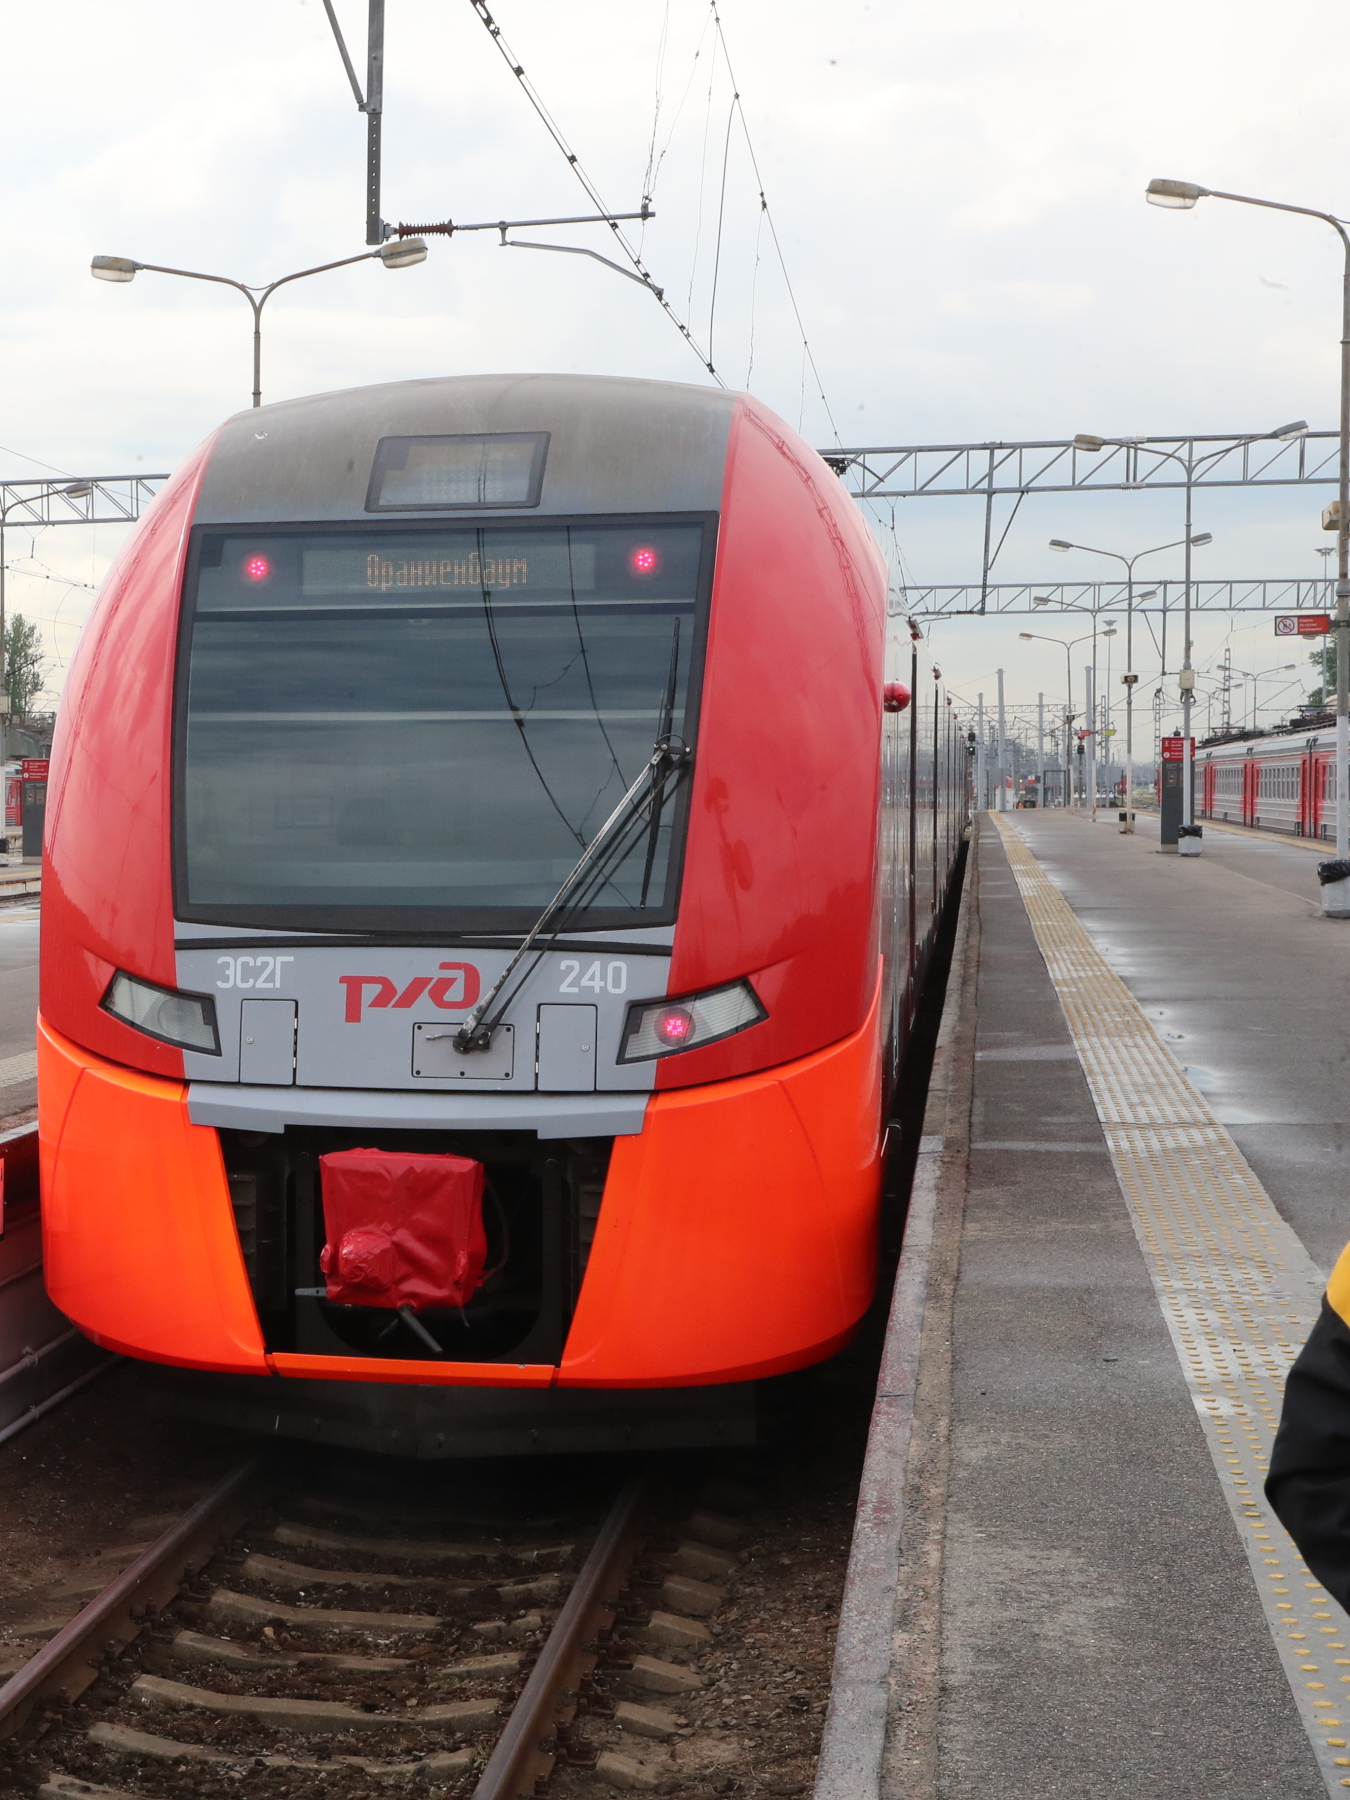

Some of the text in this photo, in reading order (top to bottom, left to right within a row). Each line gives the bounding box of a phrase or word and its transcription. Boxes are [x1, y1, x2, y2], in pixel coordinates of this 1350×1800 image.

[366, 551, 527, 592] Ораниенбаум
[216, 956, 295, 988] ЭС2Г
[559, 959, 628, 995] 240
